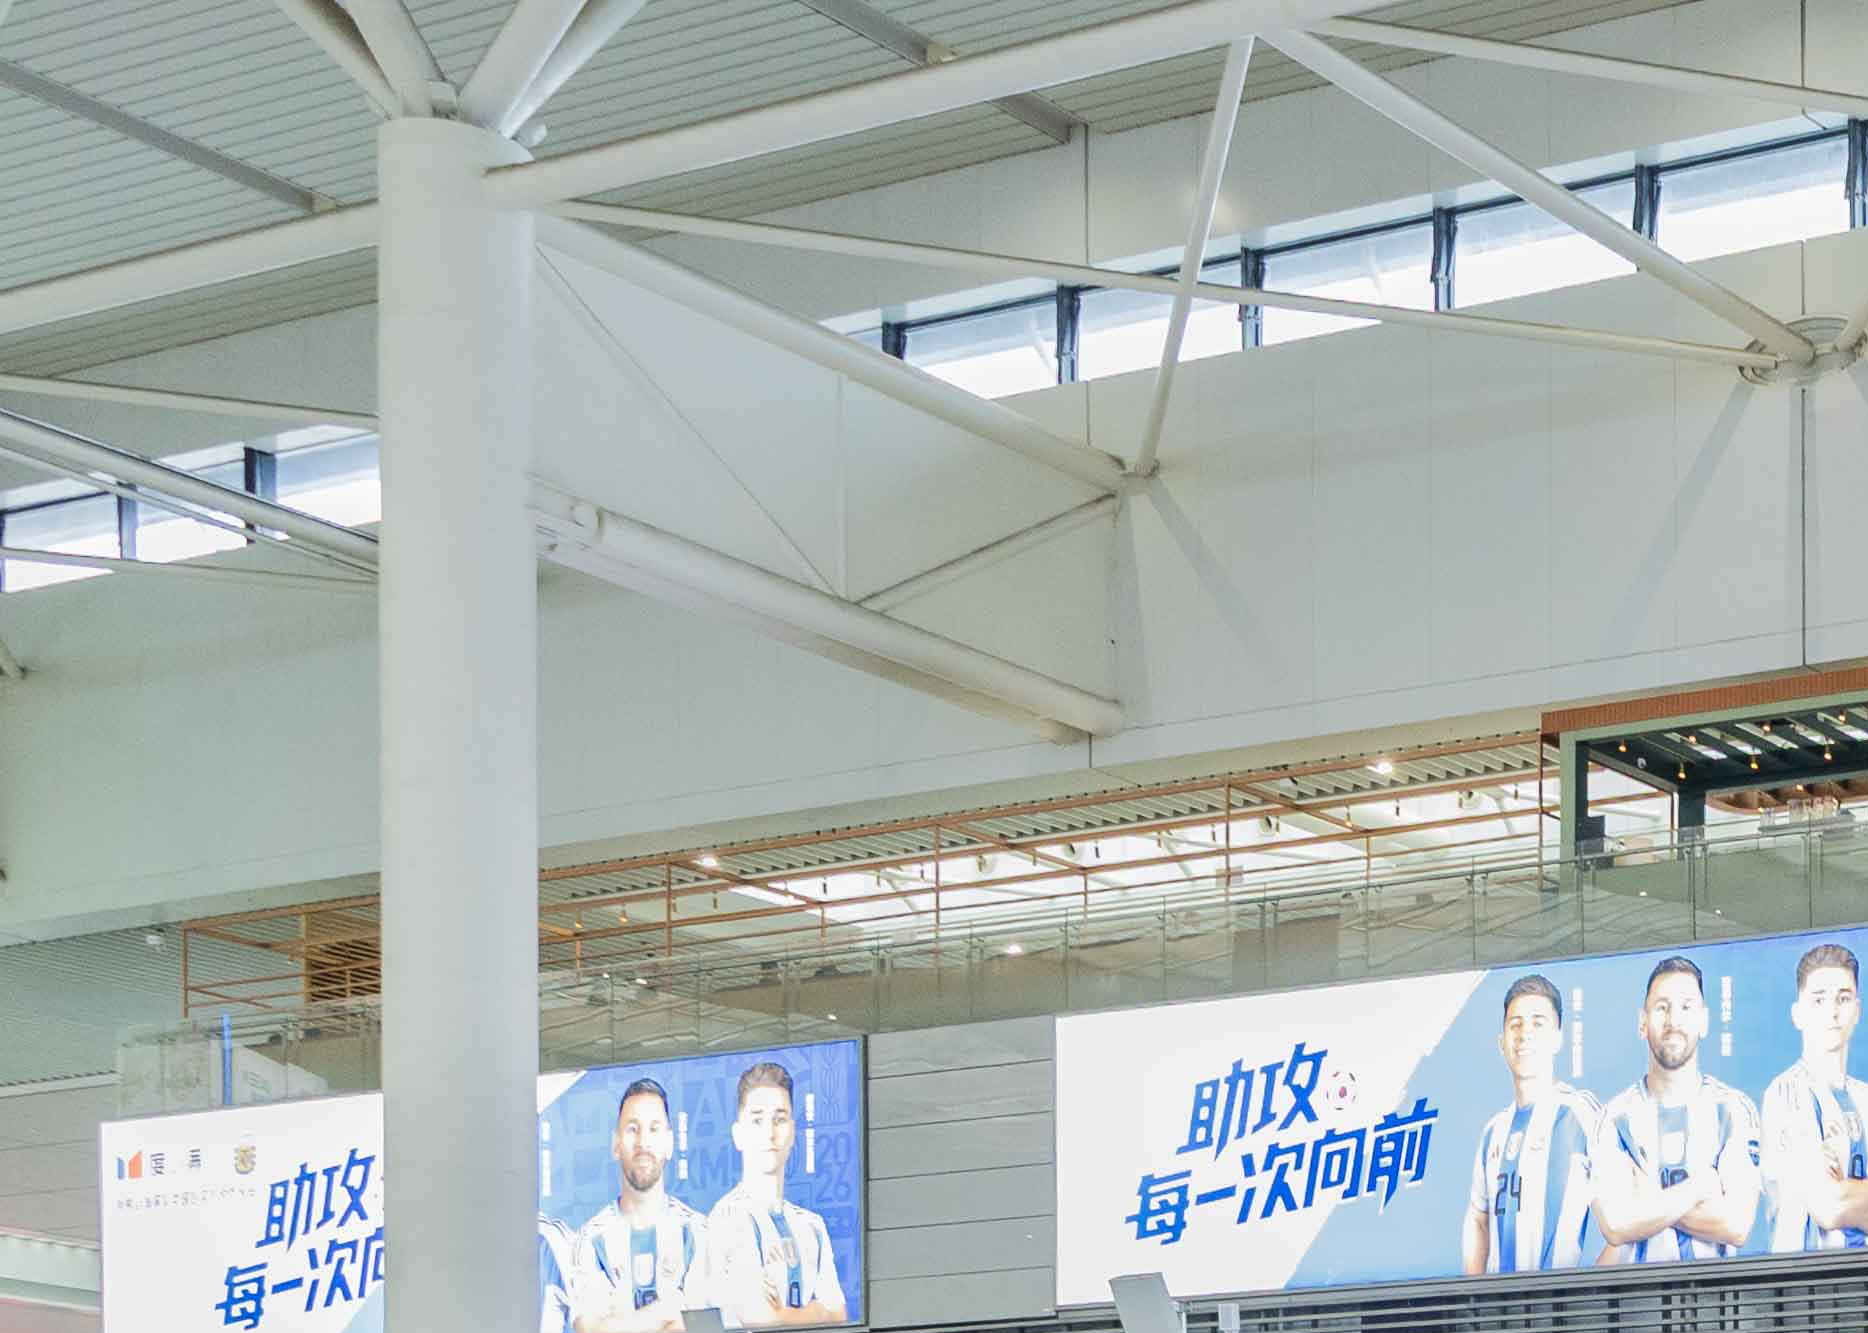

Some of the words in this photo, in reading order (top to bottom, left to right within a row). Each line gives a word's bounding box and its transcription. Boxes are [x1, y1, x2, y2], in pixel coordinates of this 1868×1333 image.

[1176, 1042, 1328, 1161] 助攻
[256, 1148, 376, 1248] 助攻
[1125, 1098, 1438, 1245] 每一次向前
